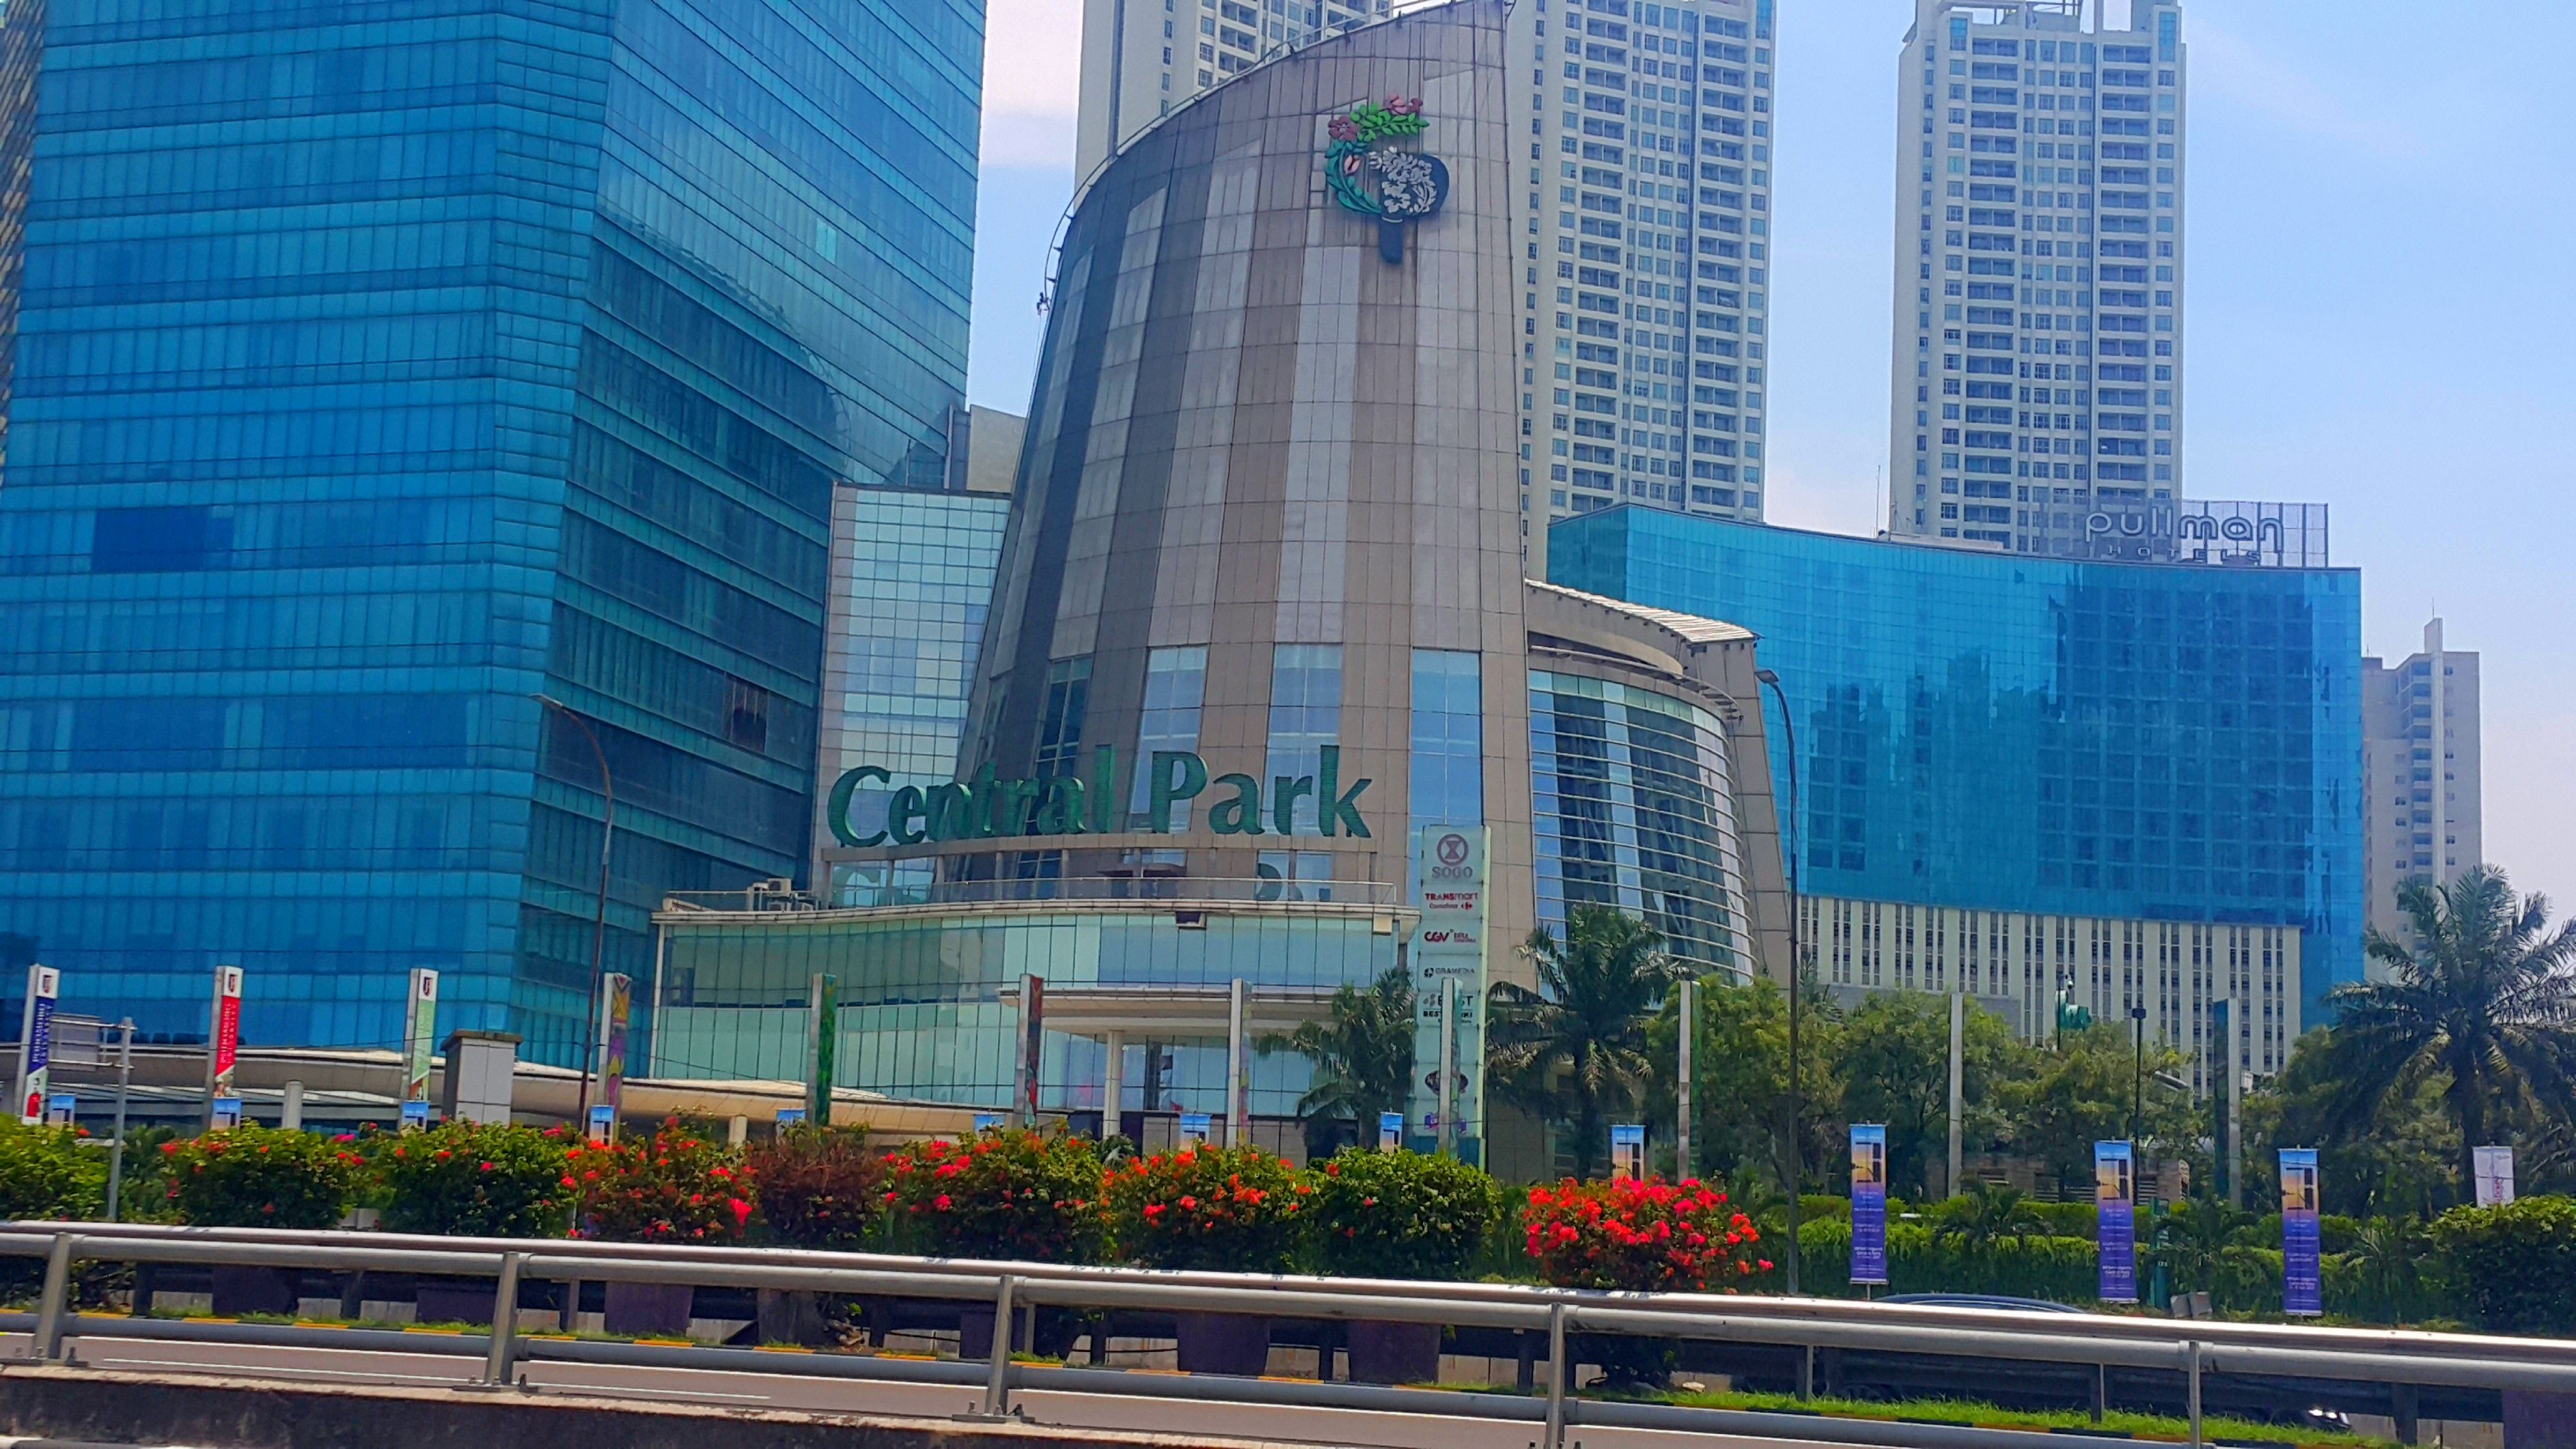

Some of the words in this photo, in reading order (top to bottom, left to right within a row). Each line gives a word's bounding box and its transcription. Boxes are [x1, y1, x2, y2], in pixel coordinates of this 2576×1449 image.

[2085, 506, 2284, 555] pullman
[2108, 546, 2261, 563] HOTELS
[827, 745, 1118, 847] Central
[1152, 744, 1373, 838] Park
[1432, 866, 1473, 879] SOGO
[1424, 931, 1450, 942] CGV
